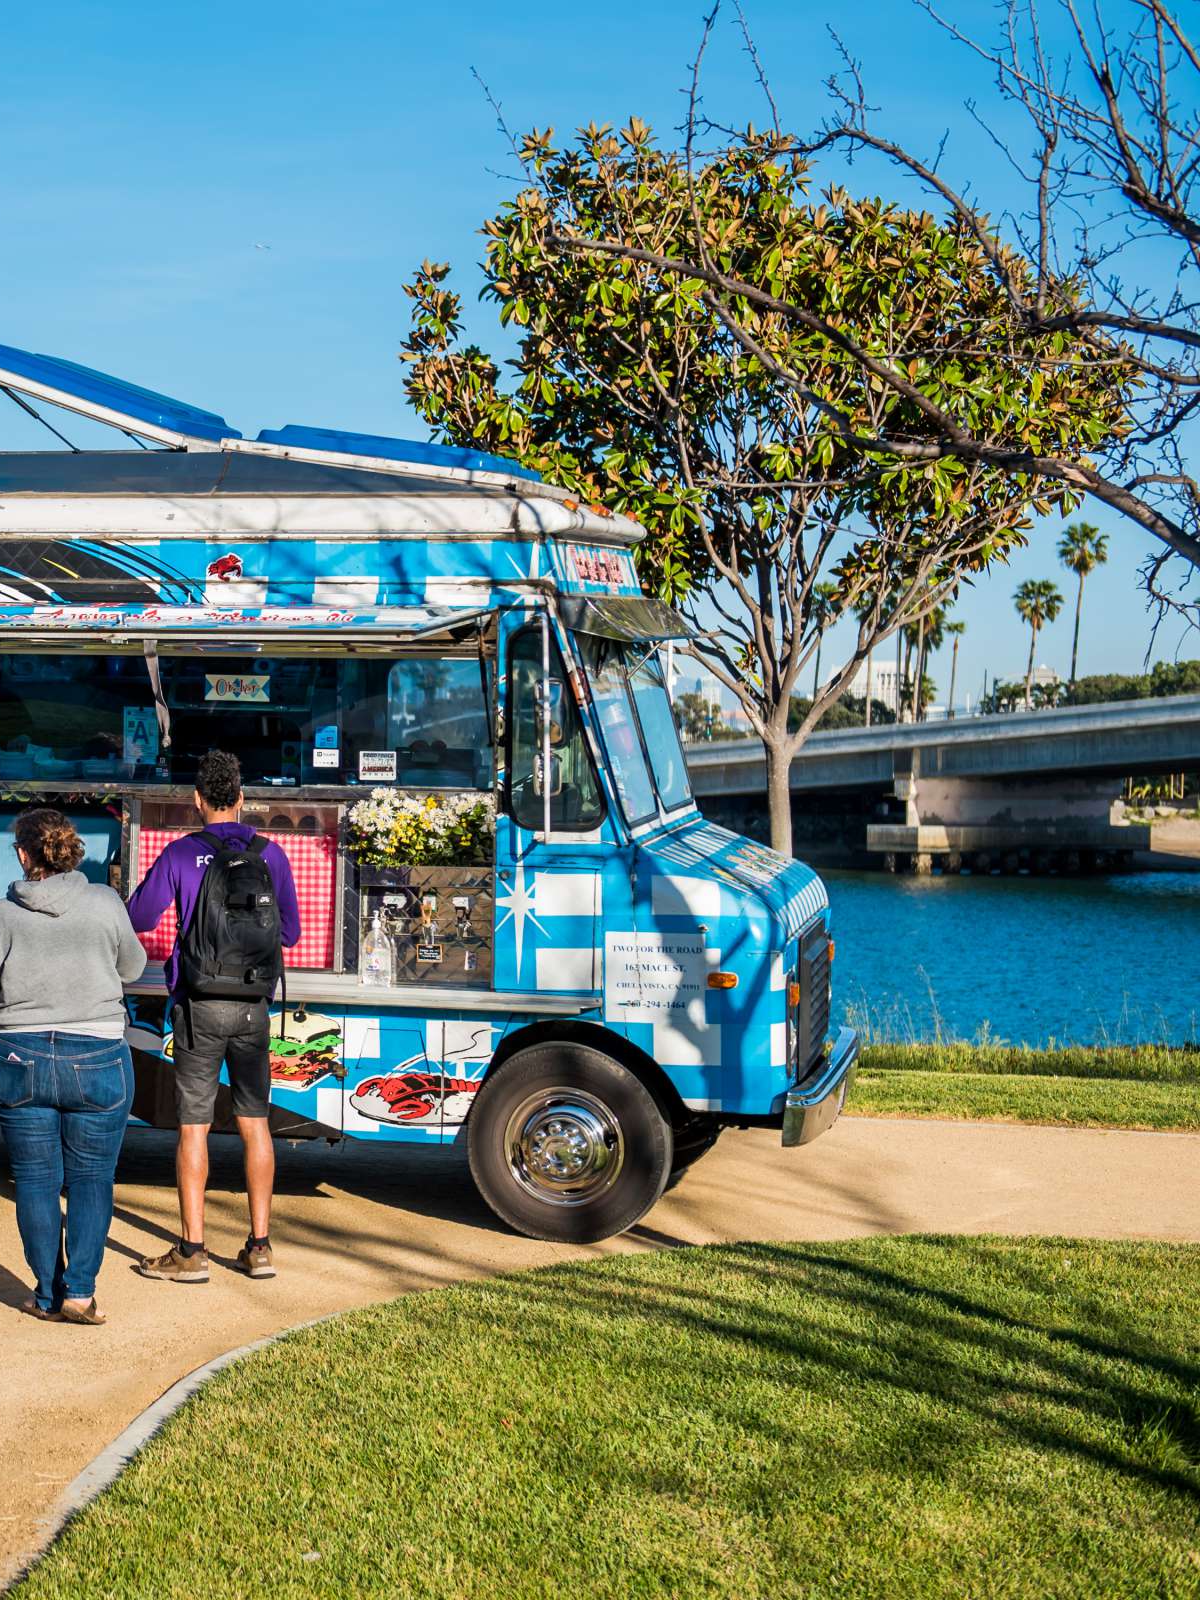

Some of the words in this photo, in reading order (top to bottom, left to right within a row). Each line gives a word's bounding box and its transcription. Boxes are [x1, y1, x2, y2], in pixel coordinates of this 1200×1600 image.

[132, 721, 150, 745] A
[612, 945, 633, 953] TWO
[635, 945, 654, 953] FOR
[657, 946, 675, 954] THE
[676, 946, 703, 954] ROAD
[641, 963, 669, 973] MACE
[616, 982, 642, 990] CHULA
